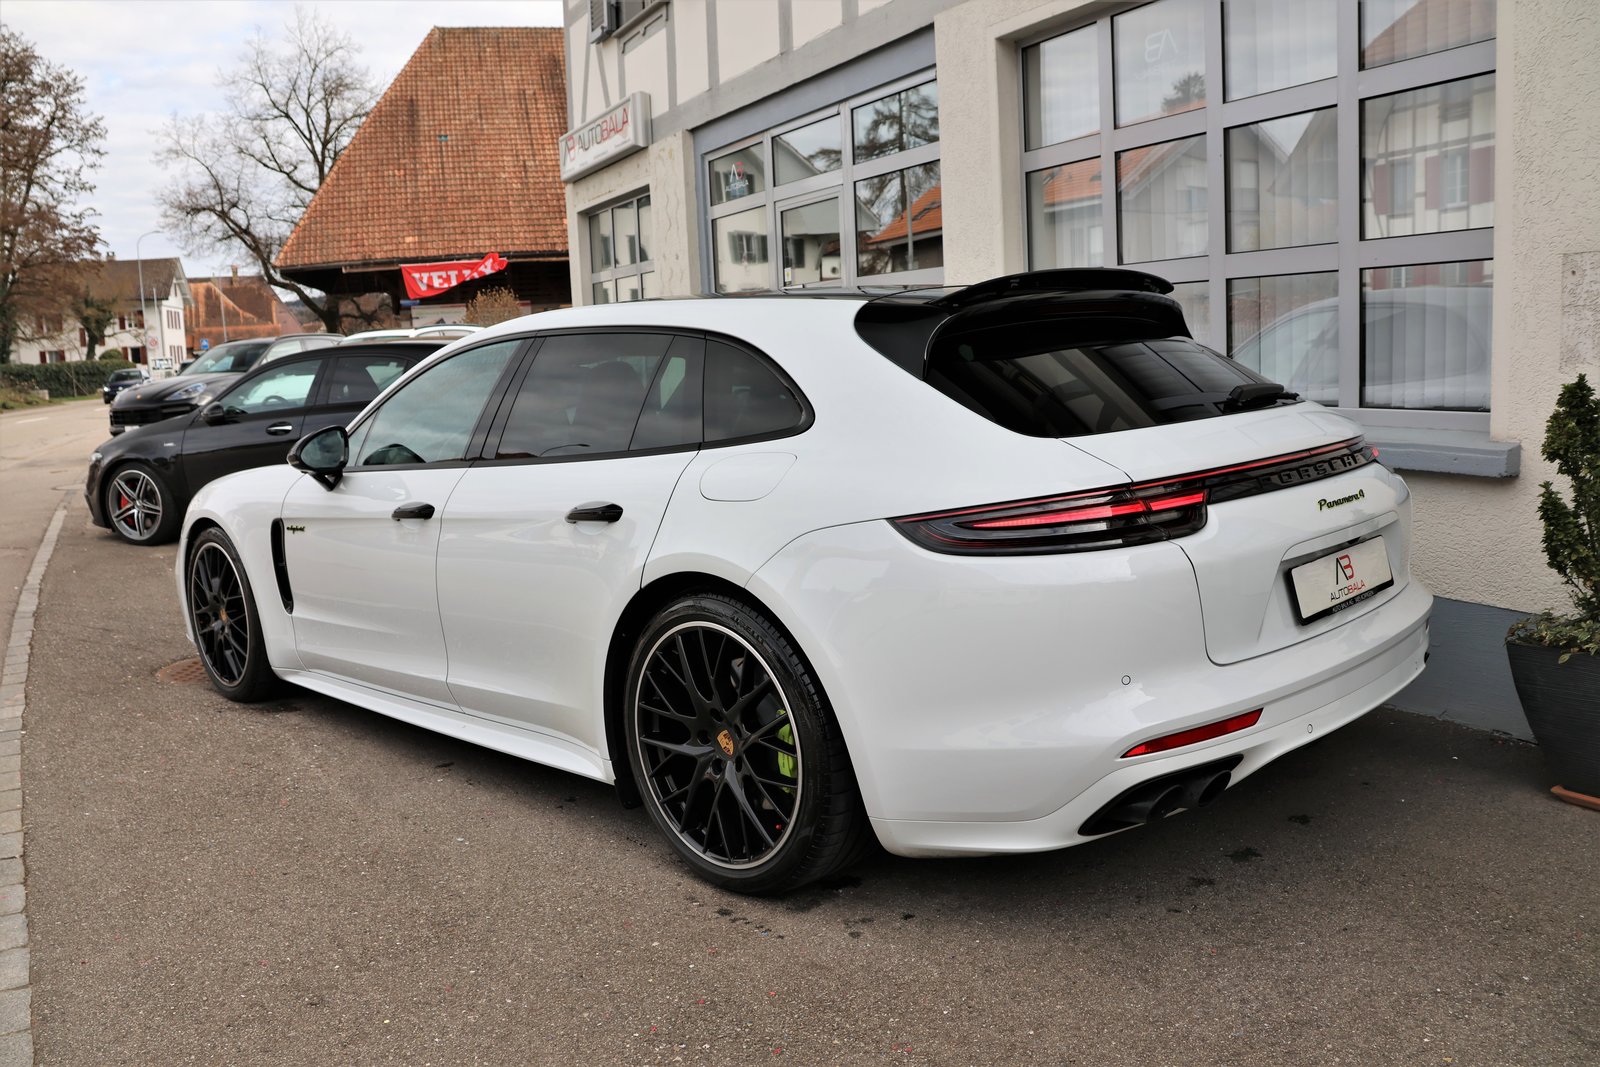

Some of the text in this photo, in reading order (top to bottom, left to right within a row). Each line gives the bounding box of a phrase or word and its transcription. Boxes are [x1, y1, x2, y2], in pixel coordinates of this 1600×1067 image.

[578, 107, 629, 152] AUTOBALA
[1317, 494, 1359, 512] Panamera
[1330, 579, 1366, 602] AUTOBALA
